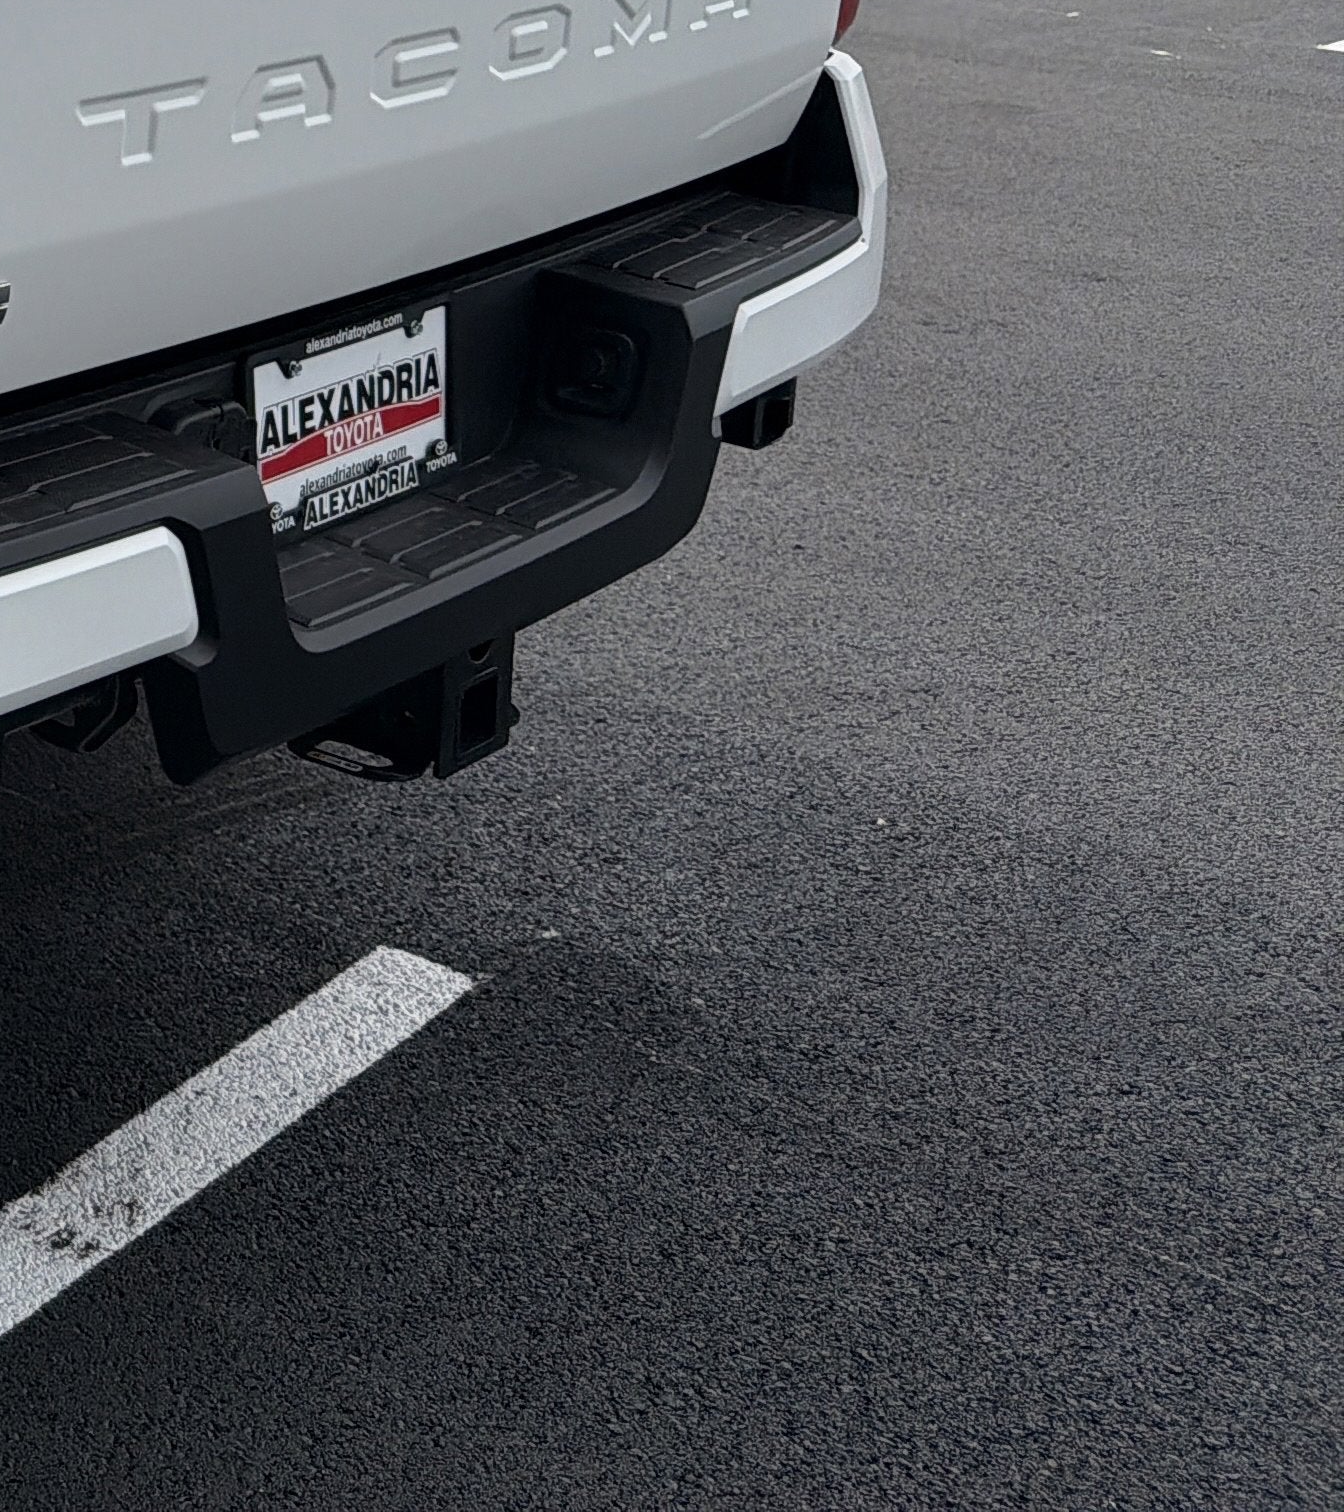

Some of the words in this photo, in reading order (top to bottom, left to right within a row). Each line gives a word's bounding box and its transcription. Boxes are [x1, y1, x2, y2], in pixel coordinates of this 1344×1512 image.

[305, 312, 404, 355] alexandriatoyota.com
[261, 351, 440, 455] ALEXANDRIA
[323, 412, 384, 456] TOYOTA
[298, 445, 408, 498] alexandriatoyota.com
[426, 452, 458, 474] TOYOTA
[304, 460, 419, 530] ALEXANDRIA
[271, 515, 297, 535] YOTA
